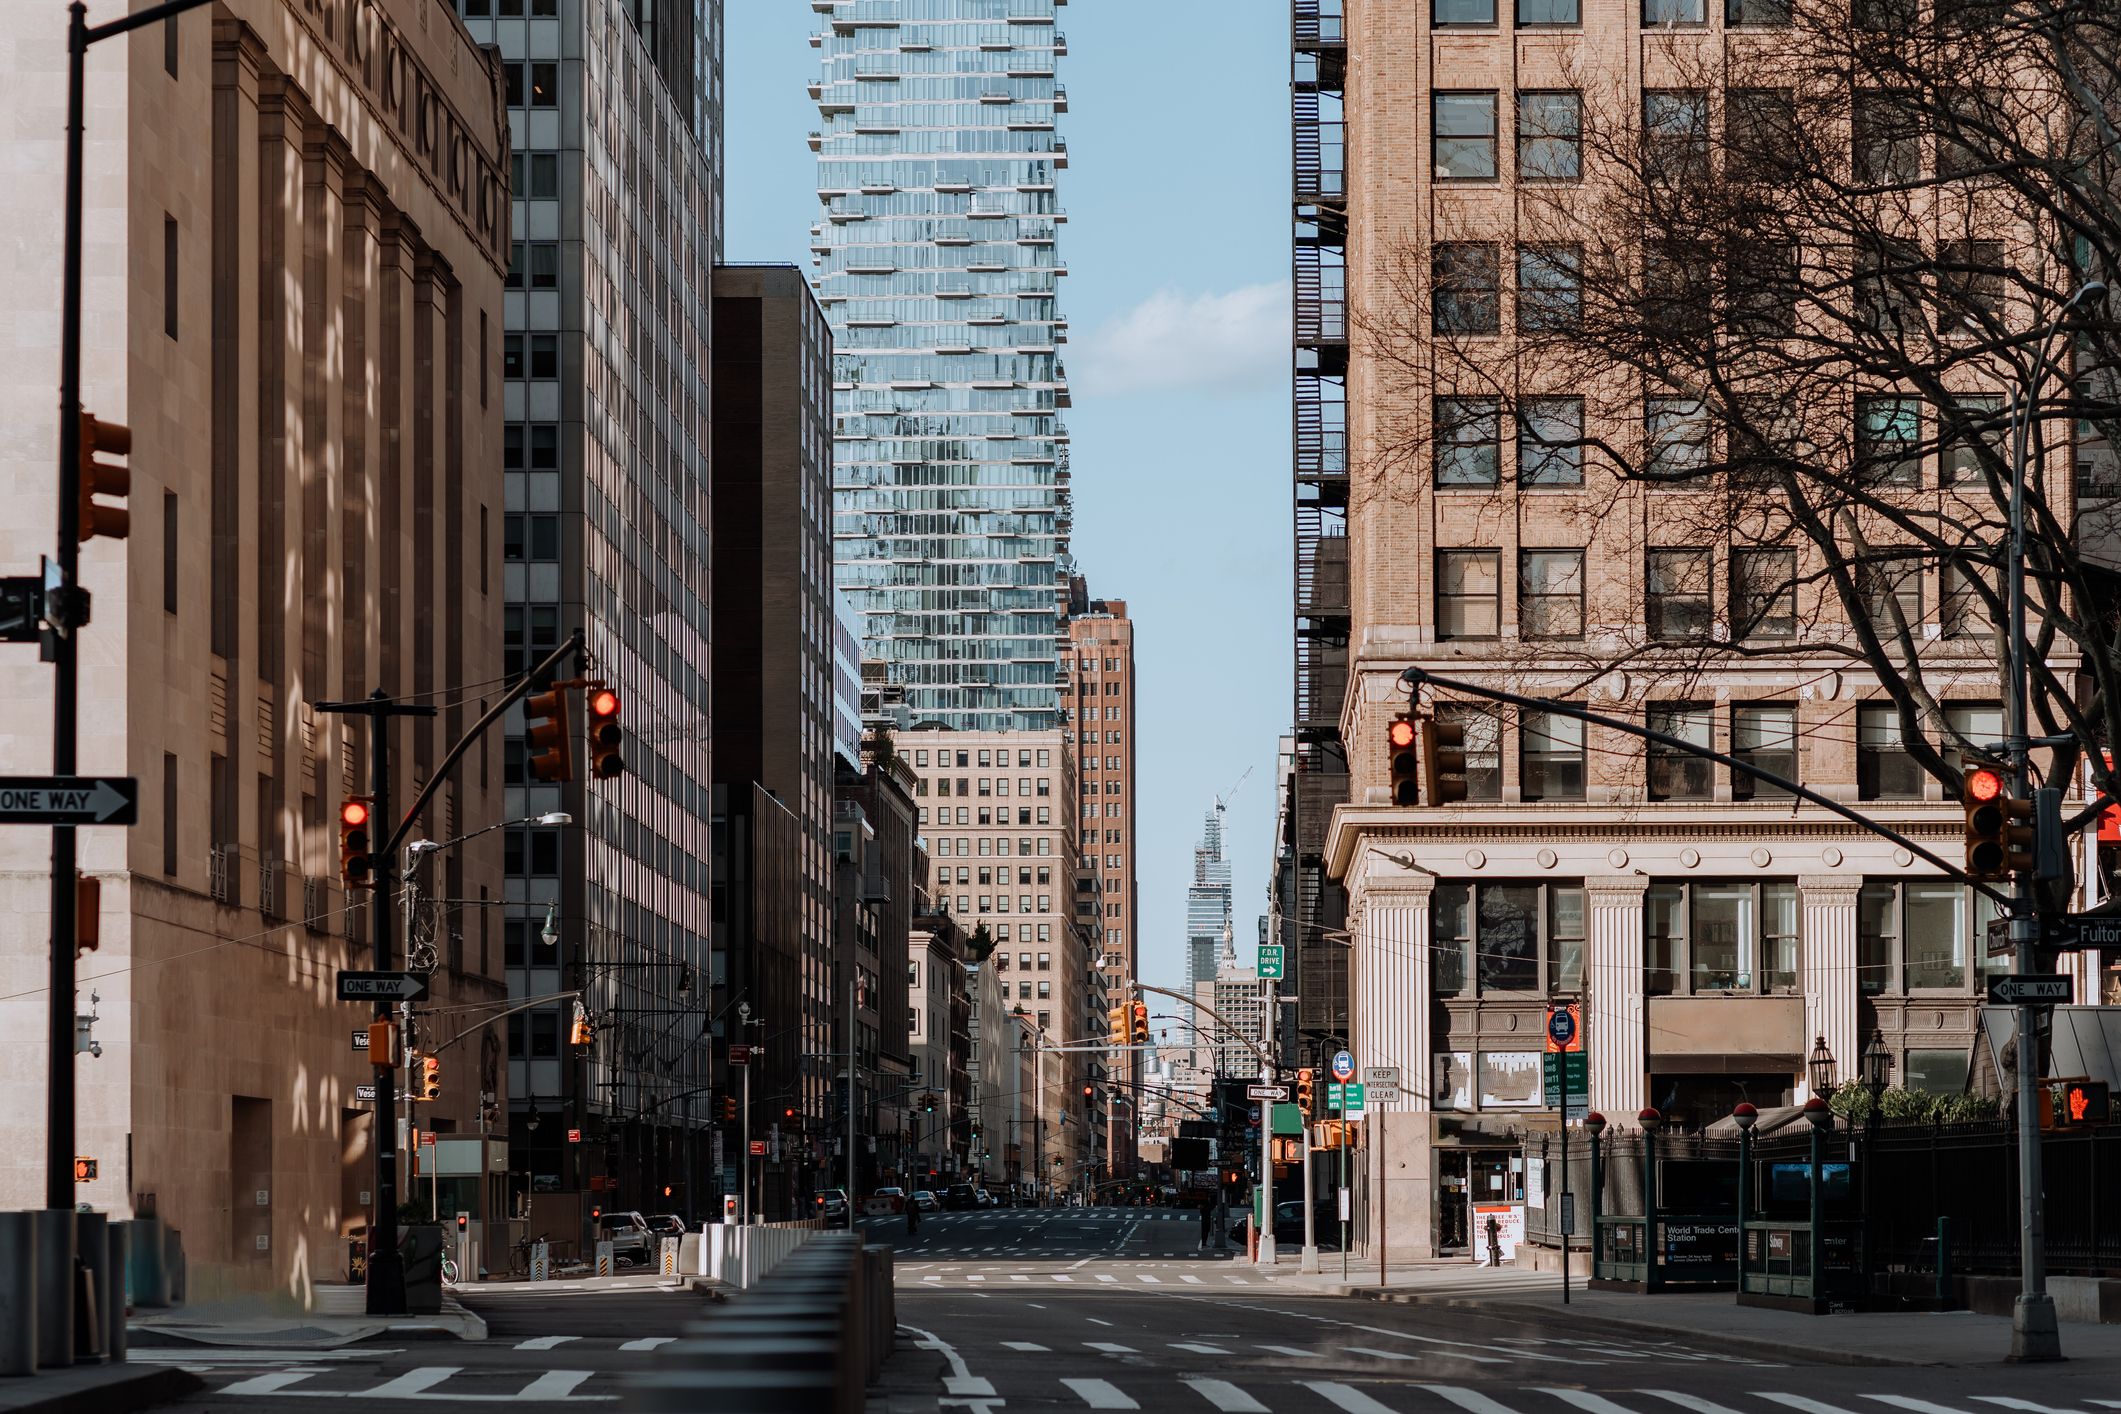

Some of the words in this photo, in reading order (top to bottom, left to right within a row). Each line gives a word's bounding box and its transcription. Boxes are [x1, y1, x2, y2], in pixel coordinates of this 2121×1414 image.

[1, 791, 41, 809] ONE
[49, 791, 90, 809] WAY
[1262, 948, 1278, 956] F.D.R.
[1260, 957, 1280, 965] DRIVE
[347, 981, 372, 992] ONE
[376, 981, 402, 992] WAY
[2001, 984, 2025, 995] ONE
[2036, 984, 2062, 995] WAY
[354, 1036, 370, 1046] Vese
[1373, 1071, 1392, 1079] KEEP
[358, 1089, 375, 1098] Vese
[1370, 1091, 1394, 1099] CLEAR
[1667, 1226, 1691, 1234] World
[1693, 1226, 1715, 1234] Trade
[1718, 1226, 1740, 1234] Cent
[1667, 1233, 1697, 1242] Station
